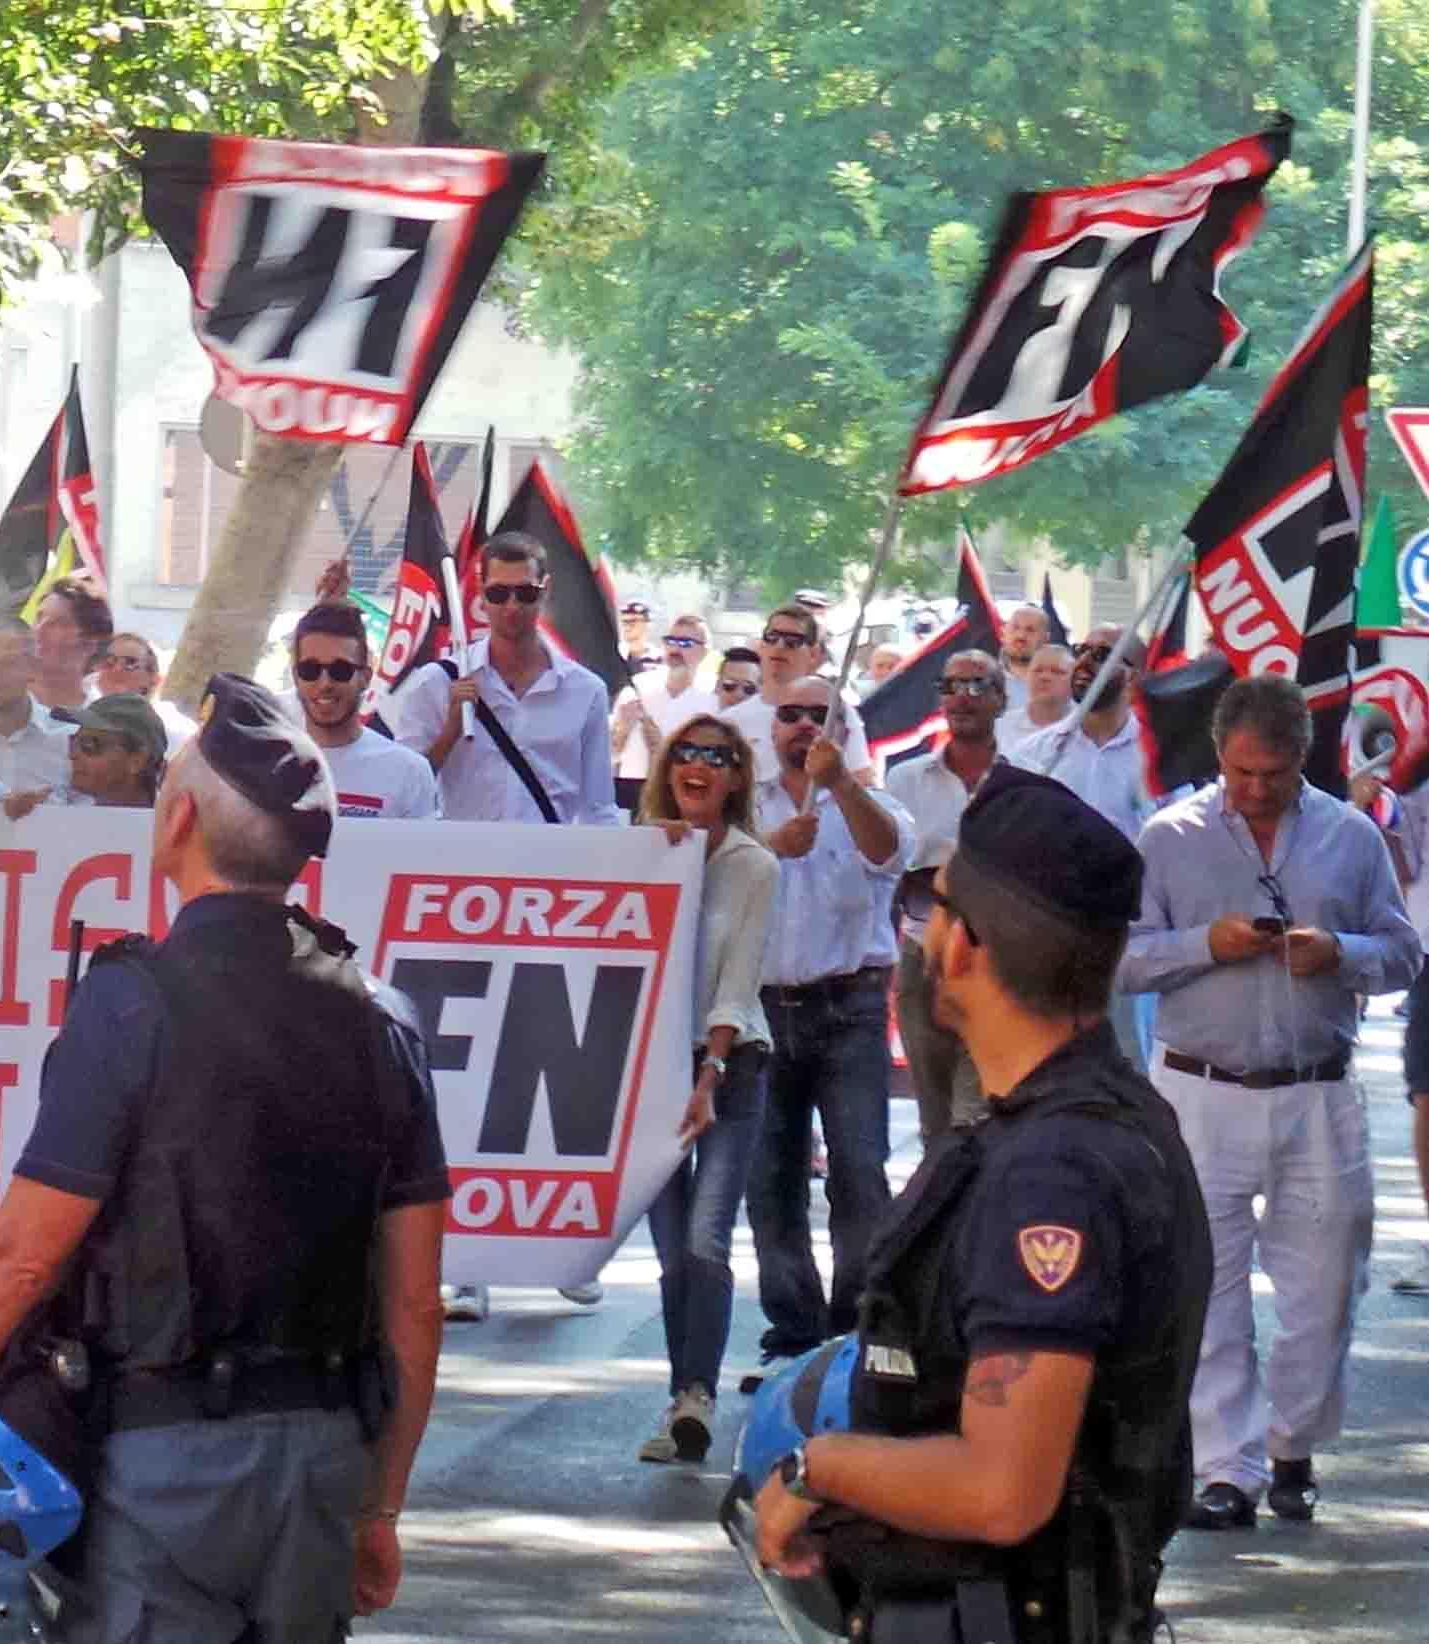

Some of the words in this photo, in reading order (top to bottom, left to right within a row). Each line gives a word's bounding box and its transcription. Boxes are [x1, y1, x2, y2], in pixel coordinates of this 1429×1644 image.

[403, 883, 652, 941] FORZA
[390, 957, 647, 1157] FN
[451, 1176, 601, 1231] OVA
